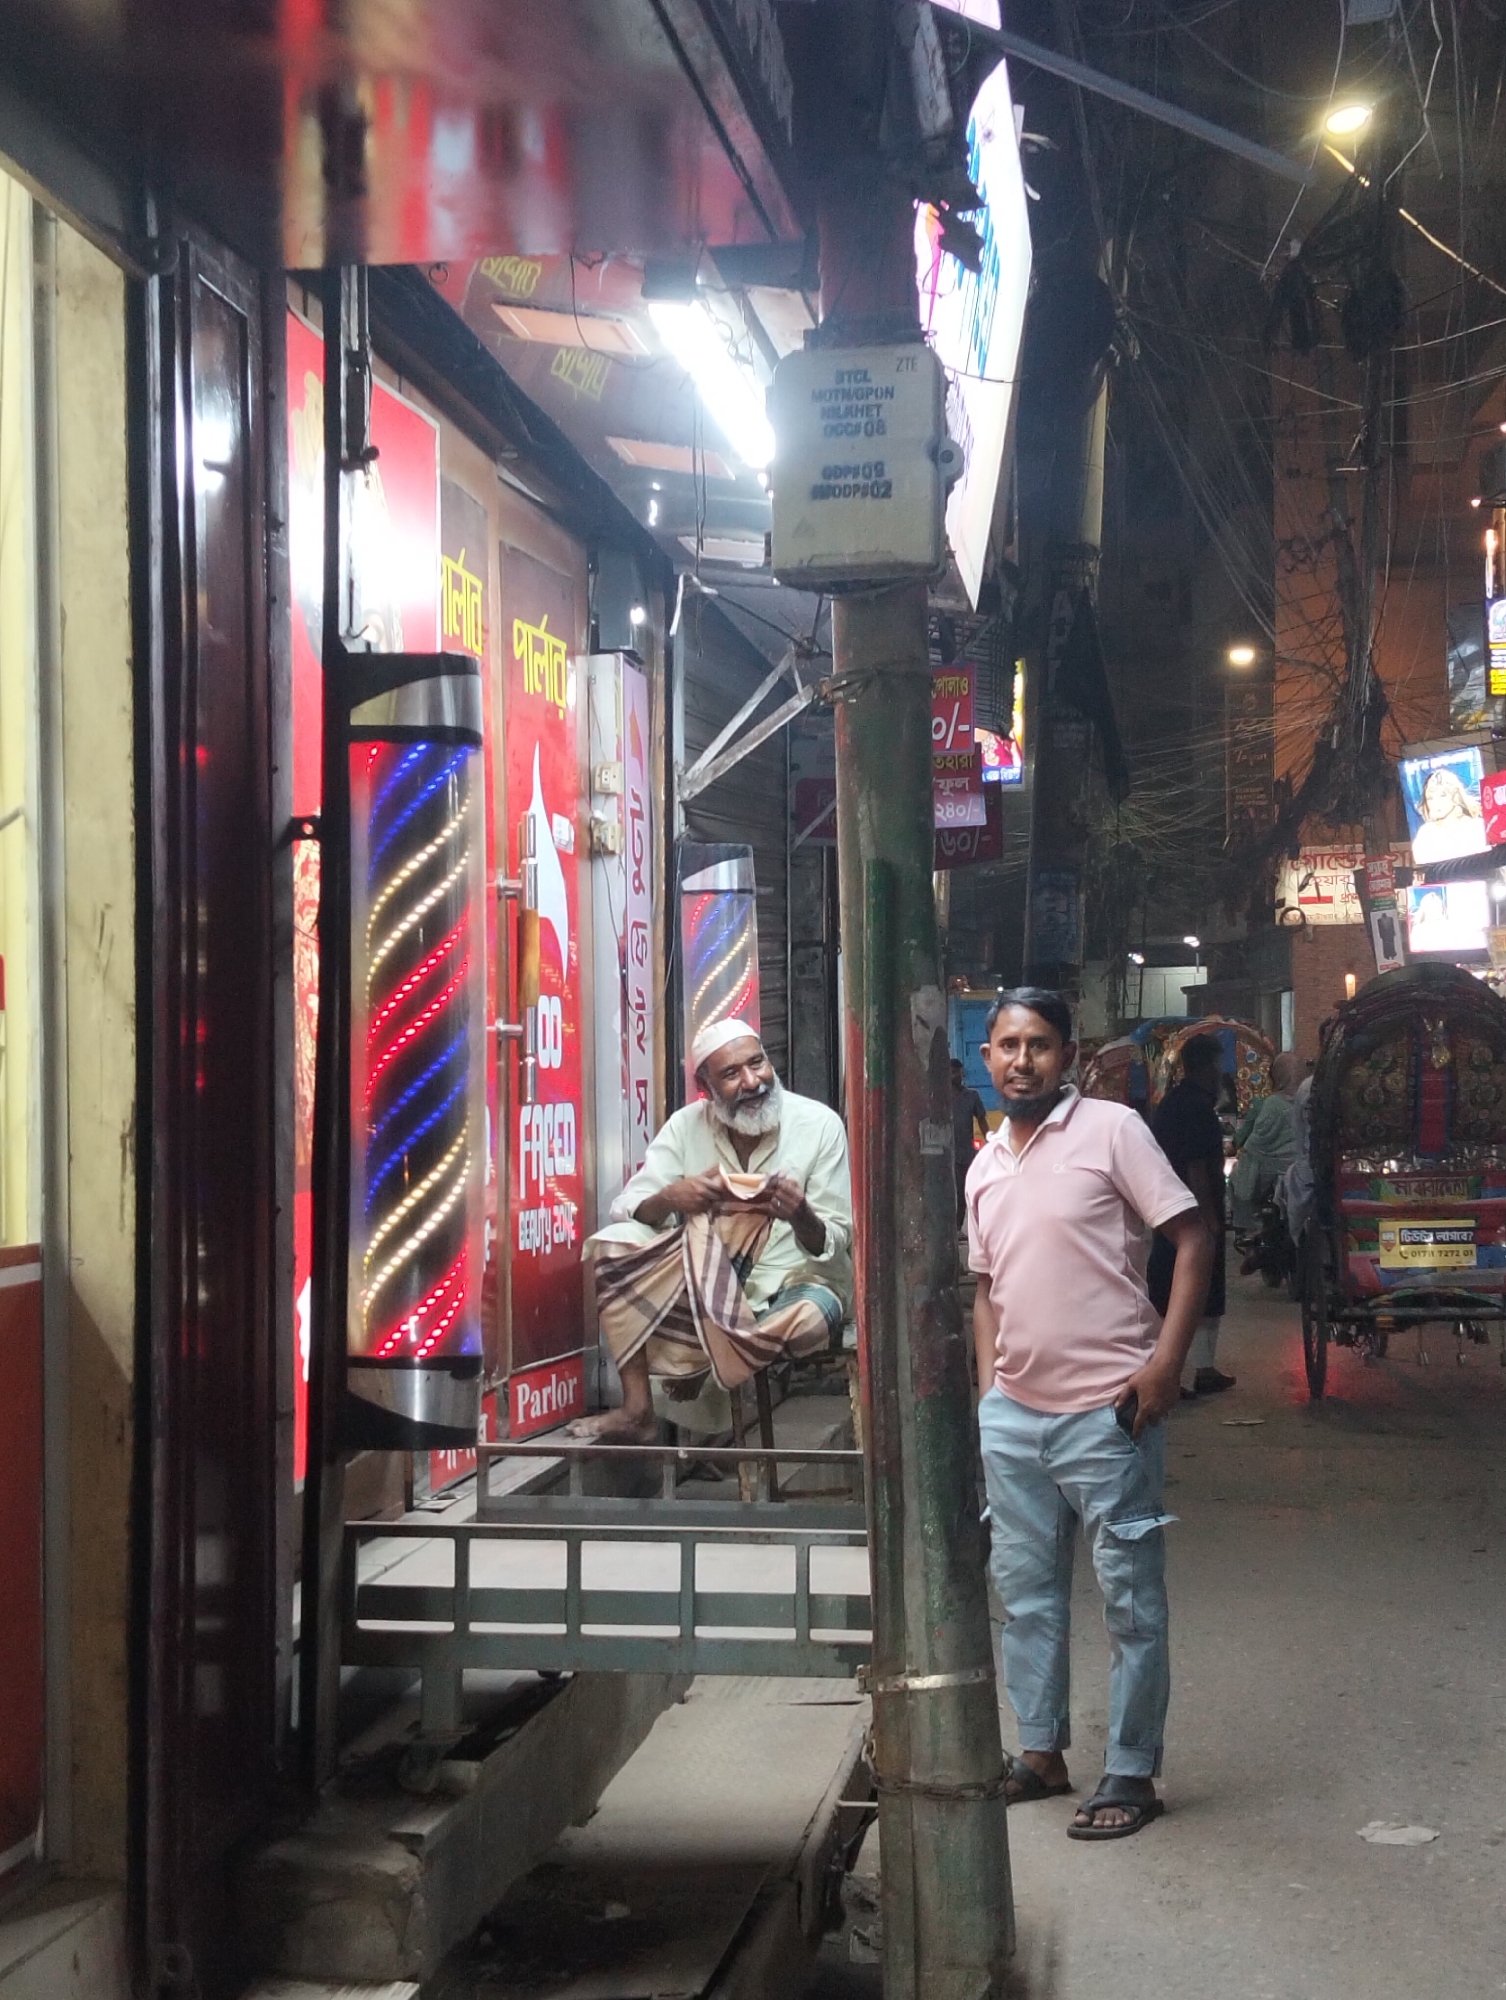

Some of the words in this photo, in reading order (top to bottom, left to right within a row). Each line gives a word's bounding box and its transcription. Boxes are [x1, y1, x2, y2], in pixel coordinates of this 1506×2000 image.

[835, 369, 872, 384] BTCL
[895, 356, 919, 373] ZTE
[512, 614, 567, 719] পার্লার
[932, 702, 970, 749] ০/-
[1290, 852, 1367, 871] গোল্ডে
[519, 1102, 576, 1199] FACED
[516, 1374, 577, 1425] Parlor
